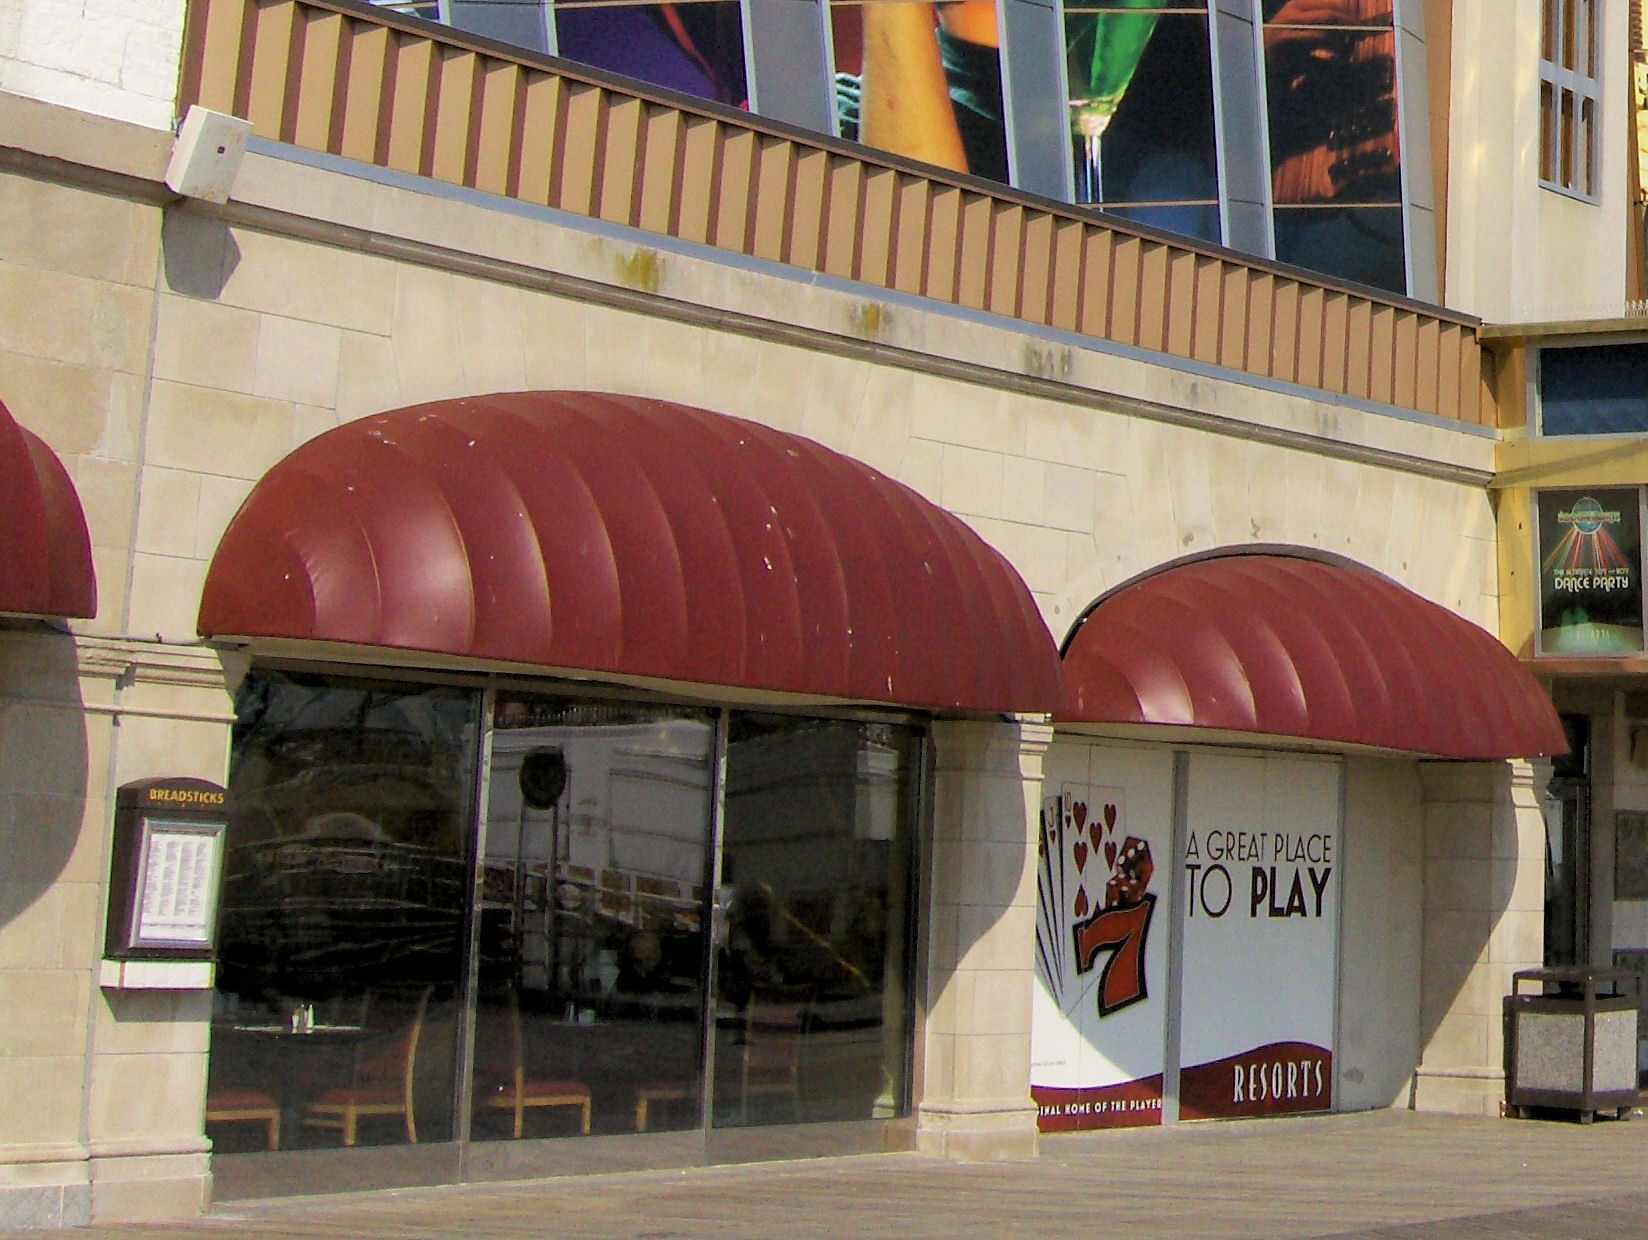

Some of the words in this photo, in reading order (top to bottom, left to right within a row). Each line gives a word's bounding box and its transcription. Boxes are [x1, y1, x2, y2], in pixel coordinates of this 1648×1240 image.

[1554, 577, 1590, 593] DANCE
[1593, 576, 1629, 592] PARTY
[149, 789, 225, 805] BREADSTICKS
[1186, 830, 1200, 861] A
[1206, 831, 1267, 861] GREAT
[1274, 833, 1332, 863] PLACE
[1186, 864, 1233, 918] TO
[1250, 867, 1332, 918] PLAY
[1233, 1059, 1325, 1103] RESORTS
[1064, 1103, 1090, 1115] HOME
[1094, 1102, 1107, 1113] OF
[1111, 1100, 1126, 1112] THE
